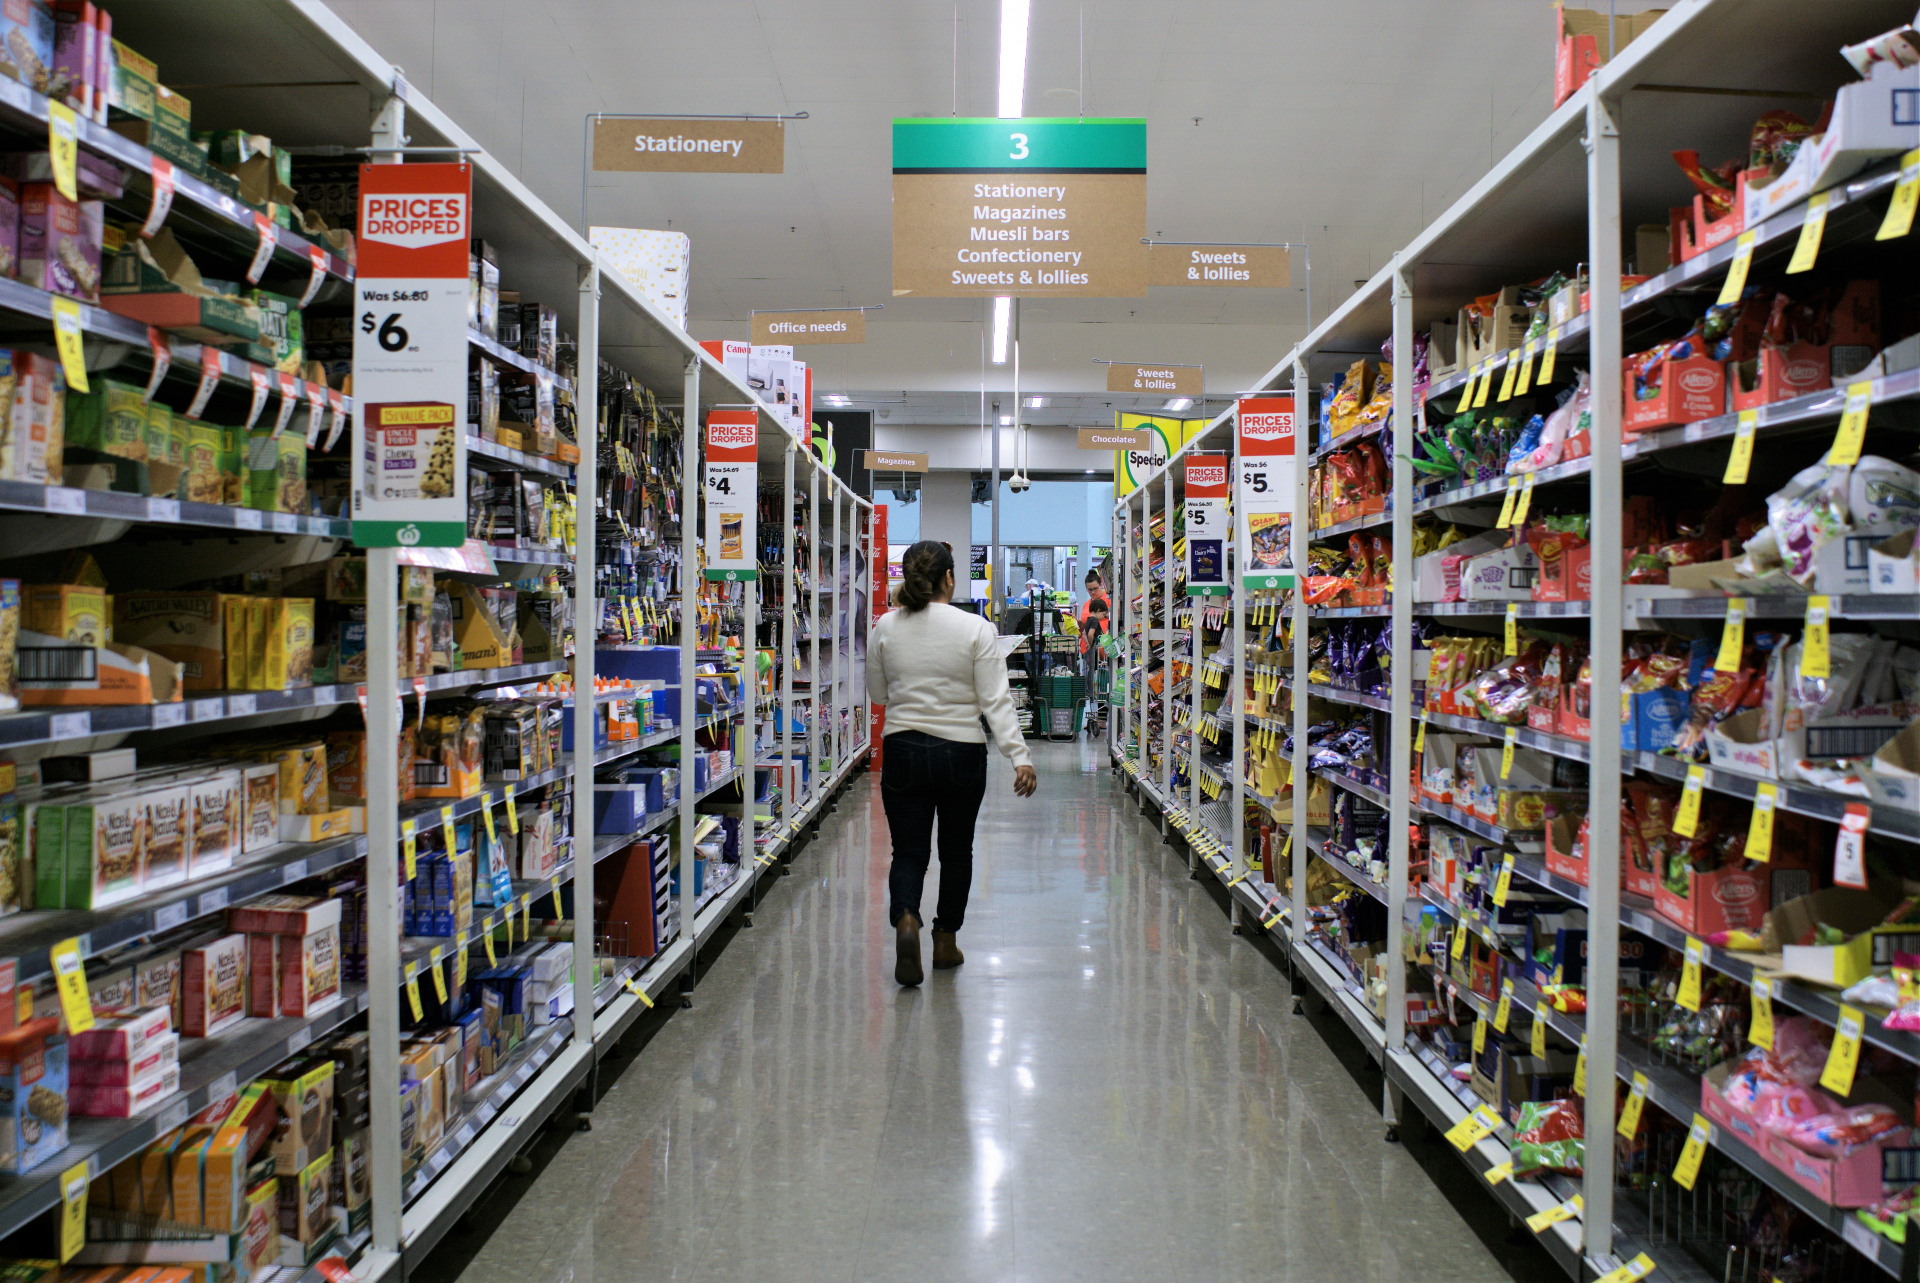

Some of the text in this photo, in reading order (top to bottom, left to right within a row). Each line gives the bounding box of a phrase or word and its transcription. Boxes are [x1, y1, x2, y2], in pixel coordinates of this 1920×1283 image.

[634, 135, 743, 157] Stationery
[1010, 133, 1029, 159] 3
[974, 183, 1066, 201] Stationery
[368, 199, 460, 218] PRICES
[973, 205, 1066, 223] Magazines
[368, 220, 460, 234] DROPPED
[970, 227, 1070, 241] Muesli bars
[957, 249, 1082, 266] Confectionery
[1191, 251, 1246, 264] Sweets
[952, 270, 1089, 284] Sweets & lollies
[1187, 267, 1250, 281] & lollies
[363, 290, 429, 302] Was $6.80
[362, 311, 409, 352] $6
[769, 321, 847, 334] Office needs
[1137, 368, 1174, 379] Sweets
[1134, 379, 1176, 390] & lollies
[400, 408, 426, 422] VALUE
[428, 408, 450, 421] PACK
[1244, 416, 1292, 426] PRICES
[387, 428, 414, 438] UNCLE
[711, 426, 754, 436] PRICES
[1244, 426, 1292, 434] DROPPED
[1092, 435, 1136, 444] Chocolates
[385, 449, 414, 460] Chewy
[877, 457, 916, 466] Magazines
[1130, 451, 1166, 468] Special
[1188, 468, 1223, 476] PRICES
[709, 476, 730, 495] $4
[1244, 472, 1268, 492] $5
[1188, 510, 1206, 525] $5
[1252, 517, 1276, 526] GIANT
